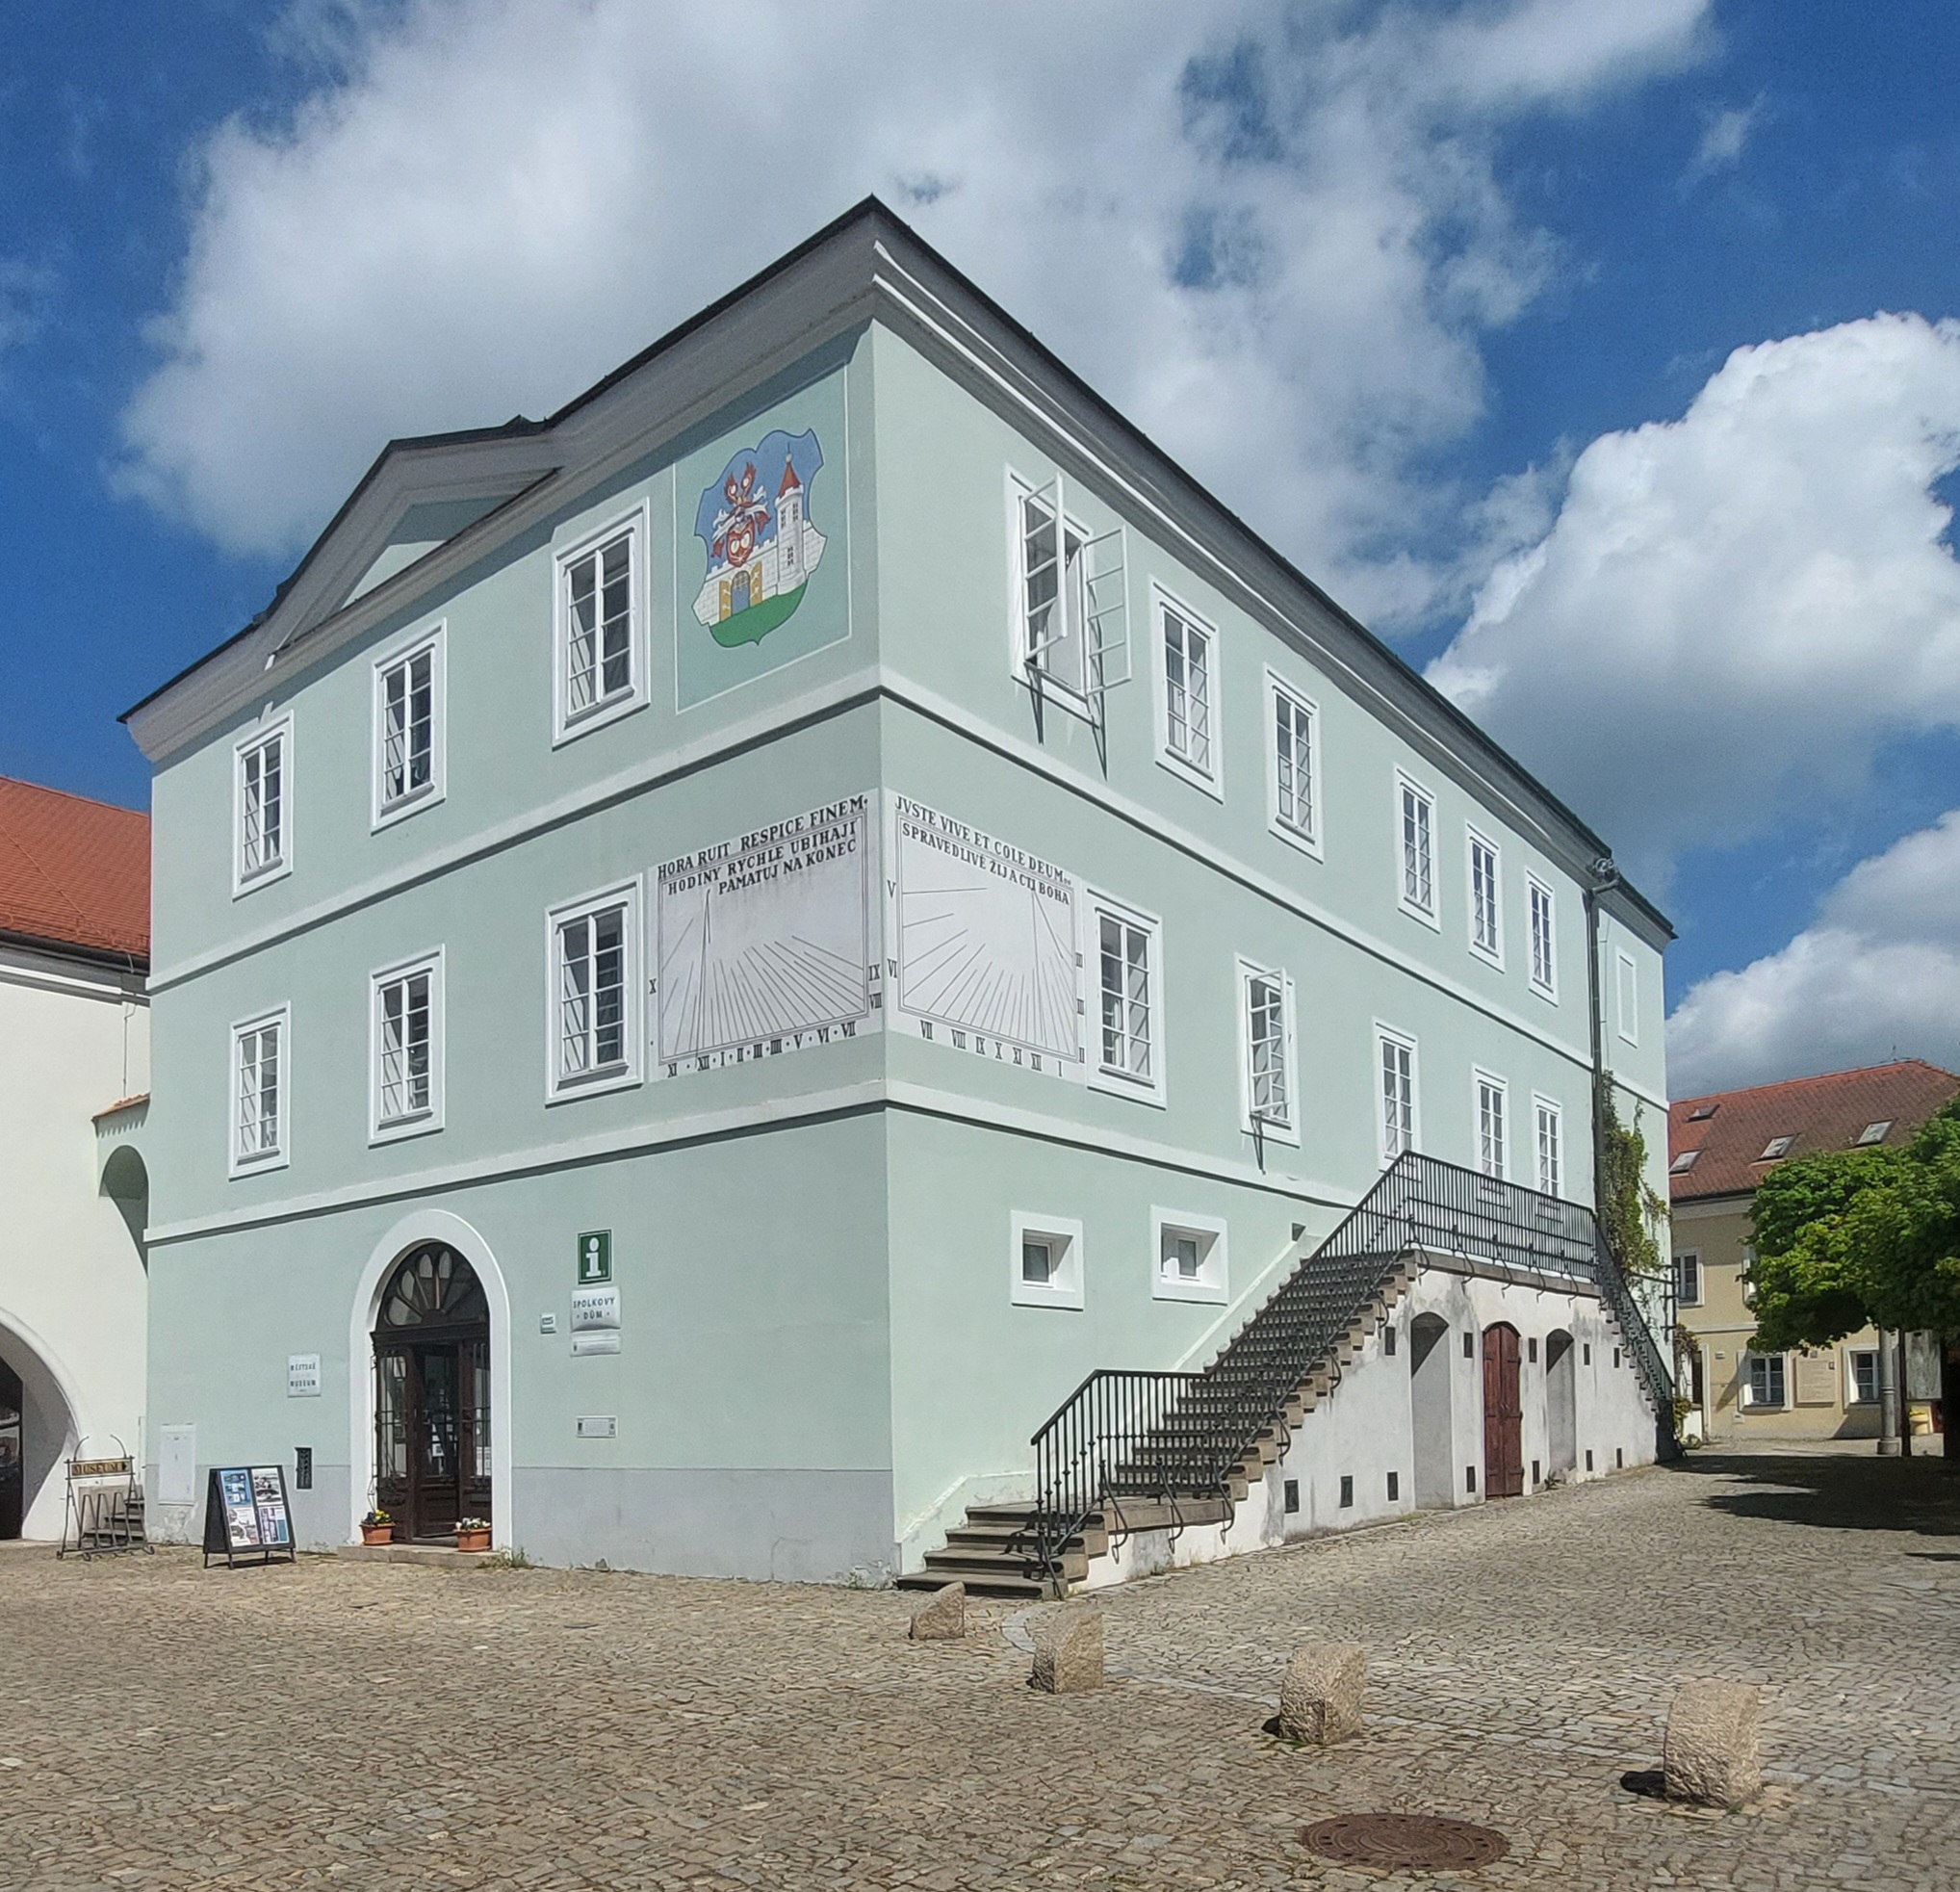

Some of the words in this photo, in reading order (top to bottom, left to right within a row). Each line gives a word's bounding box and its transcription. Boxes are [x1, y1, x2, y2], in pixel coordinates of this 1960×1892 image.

[658, 855, 693, 879] HORA
[697, 842, 731, 867] RUIT
[740, 816, 804, 852] RESPICE
[941, 815, 970, 842] VIVE
[974, 831, 990, 849] ET
[994, 841, 1025, 866] COLE
[668, 867, 721, 895] HODINY
[727, 846, 784, 876] RYCHLE
[718, 864, 778, 895] PAMATUJ
[783, 857, 803, 875] NA
[806, 839, 856, 868] KONEC
[887, 879, 896, 898] V
[1009, 868, 1018, 884] A
[1039, 881, 1070, 905] BOHA
[868, 963, 880, 981] IX
[887, 958, 897, 978] VI
[649, 978, 657, 995] X
[794, 1033, 803, 1050] V
[817, 1026, 830, 1044] VI
[994, 1041, 1003, 1060] X
